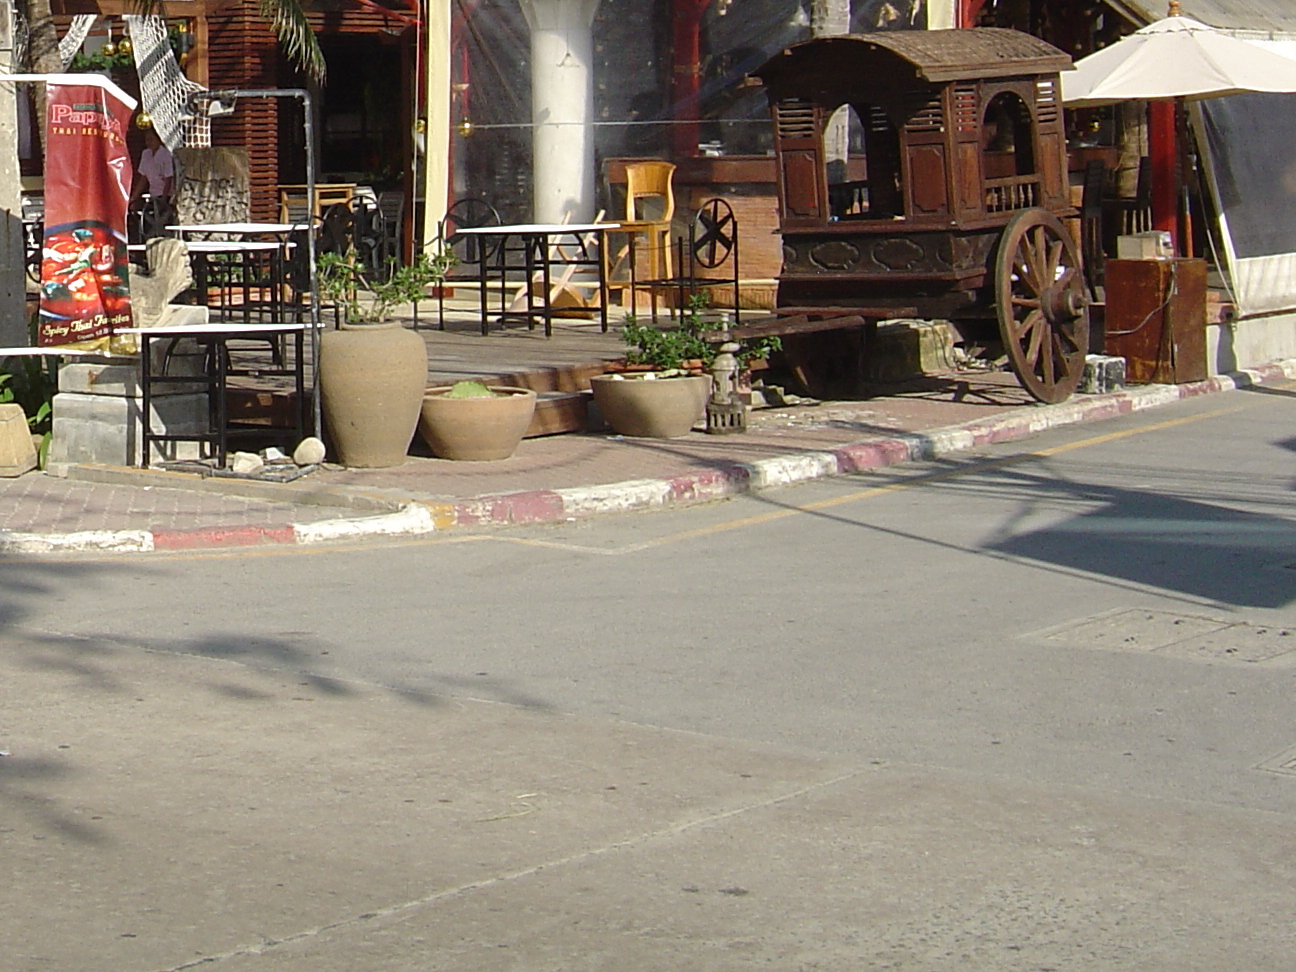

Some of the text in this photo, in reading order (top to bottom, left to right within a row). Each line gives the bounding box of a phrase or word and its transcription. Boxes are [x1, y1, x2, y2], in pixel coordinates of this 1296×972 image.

[52, 127, 77, 135] THAI
[42, 324, 70, 337] Spicy
[70, 318, 94, 332] Thai
